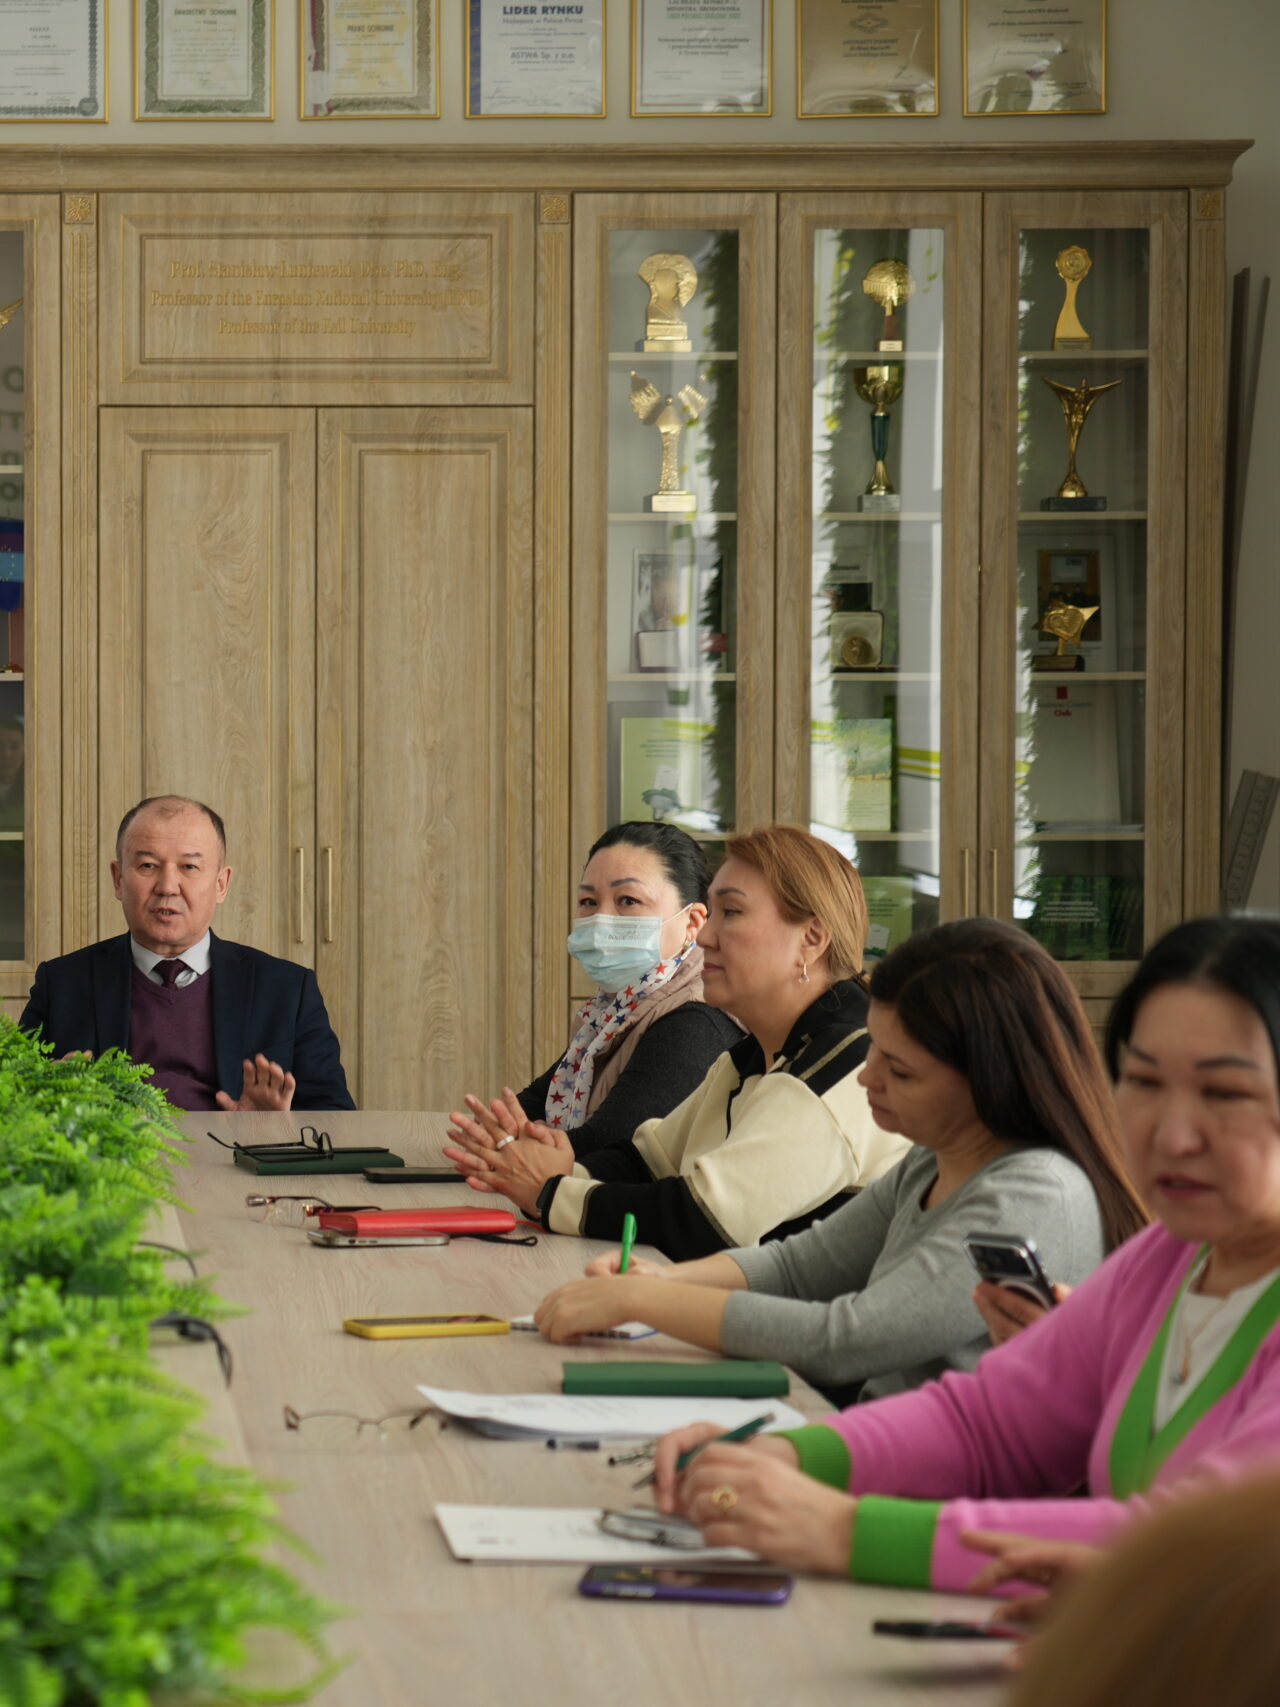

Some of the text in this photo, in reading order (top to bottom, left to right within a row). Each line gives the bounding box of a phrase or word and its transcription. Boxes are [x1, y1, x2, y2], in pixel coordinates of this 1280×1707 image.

[502, 5, 584, 15] LIDER RYNKU
[151, 289, 214, 306] Professor
[216, 289, 231, 306] of
[231, 289, 253, 306] the
[218, 318, 280, 335] Professor
[284, 318, 298, 335] of
[298, 318, 320, 335] the
